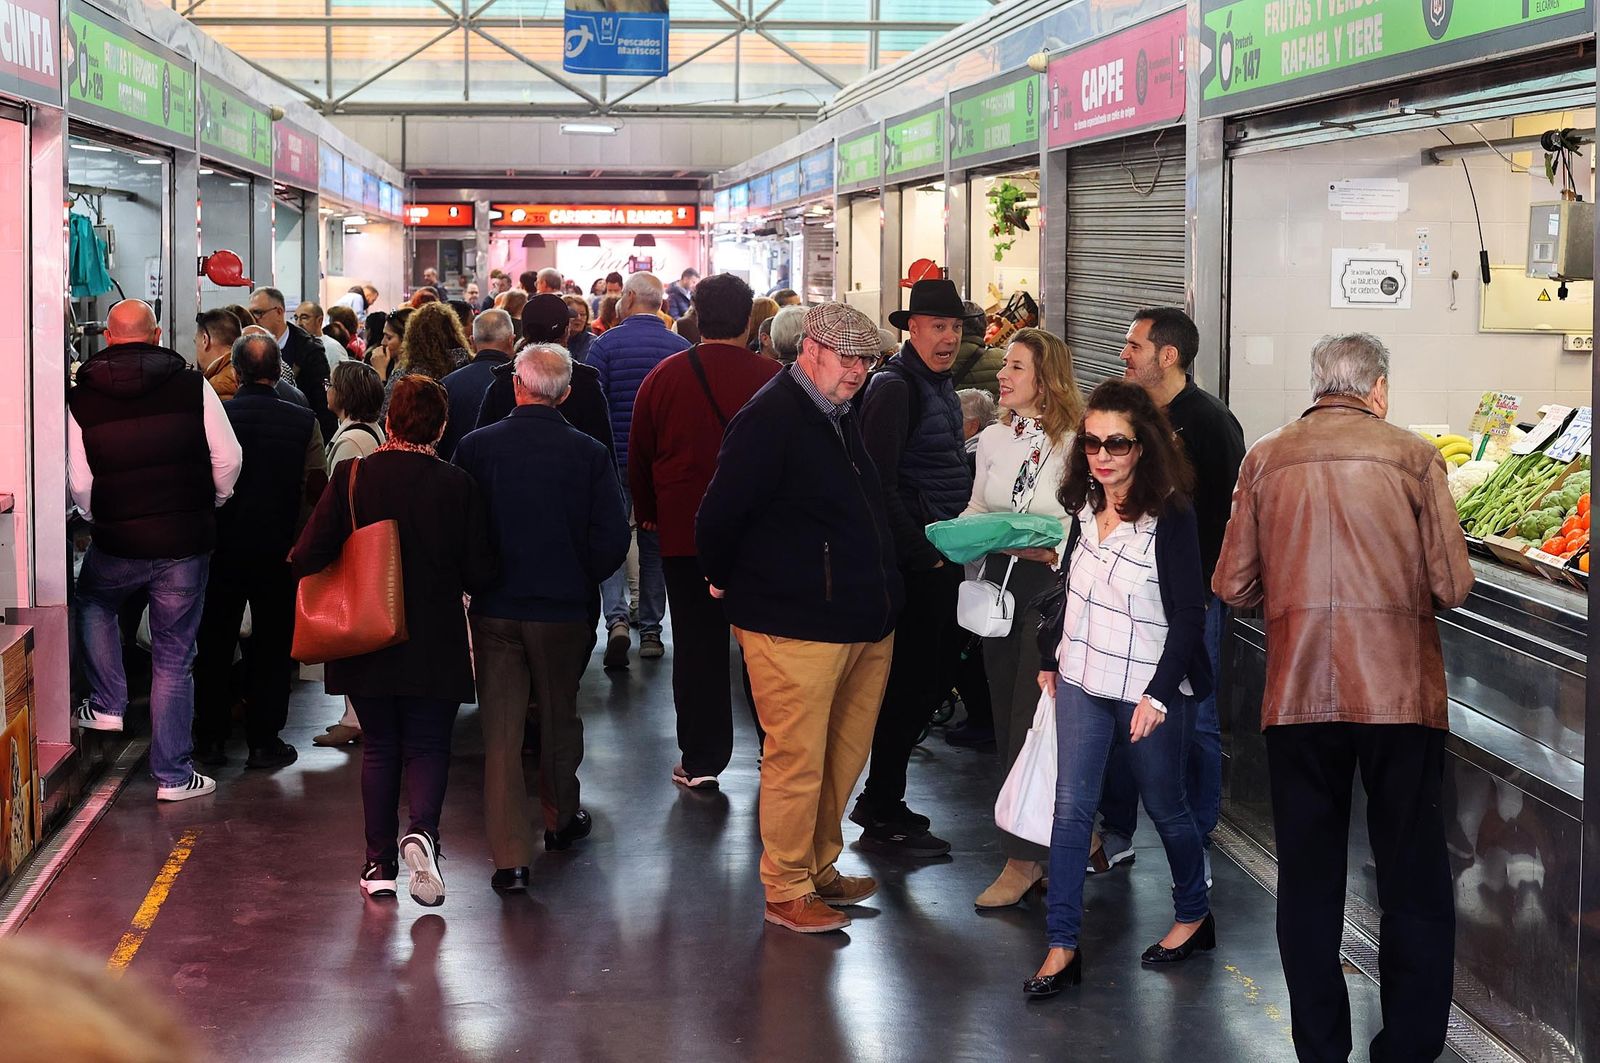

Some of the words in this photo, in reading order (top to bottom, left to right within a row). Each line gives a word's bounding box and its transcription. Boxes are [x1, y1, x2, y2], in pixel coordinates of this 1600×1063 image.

[1264, 0, 1312, 37] FRUTAS
[617, 38, 660, 47] Pescados
[617, 46, 660, 55] Mariscos
[1281, 31, 1330, 77] RAFAEL
[1334, 25, 1343, 63] Y
[1346, 13, 1383, 59] TERE
[1243, 48, 1261, 82] 147
[1082, 58, 1124, 112] CAPFE
